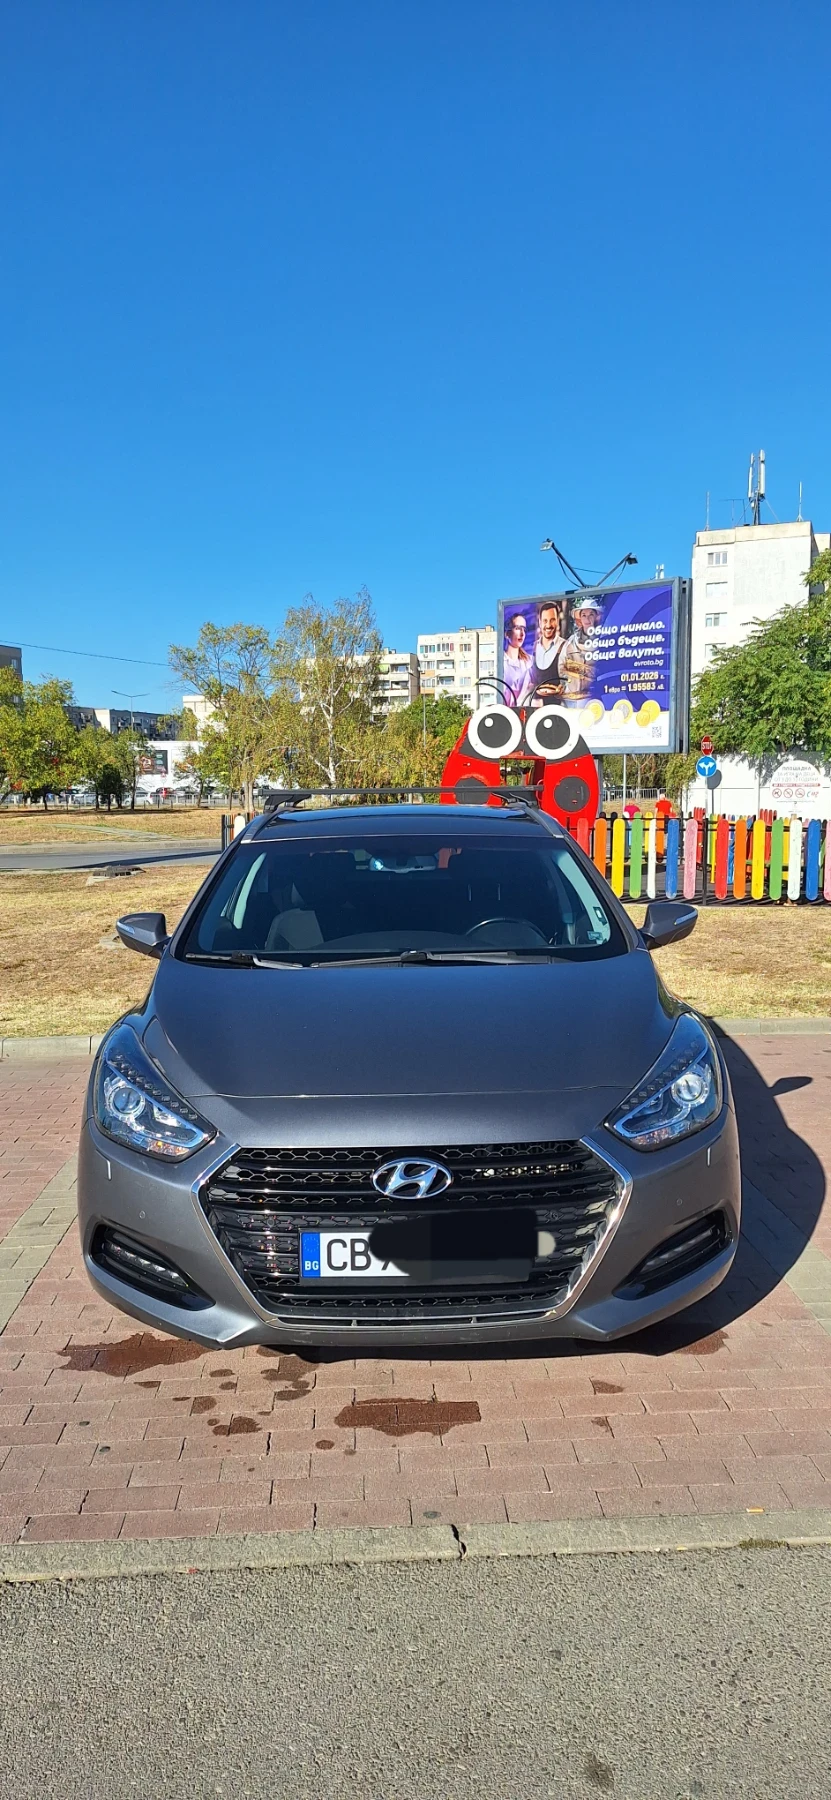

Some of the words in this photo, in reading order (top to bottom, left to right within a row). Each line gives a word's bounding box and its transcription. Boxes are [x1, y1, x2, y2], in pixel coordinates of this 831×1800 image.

[587, 625, 618, 635] Общо
[620, 621, 665, 633] минало.
[584, 638, 615, 648] Общо
[617, 634, 665, 646] бъдеще.
[585, 650, 616, 661] Обща
[618, 647, 664, 658] валута.
[304, 1260, 319, 1270] BG
